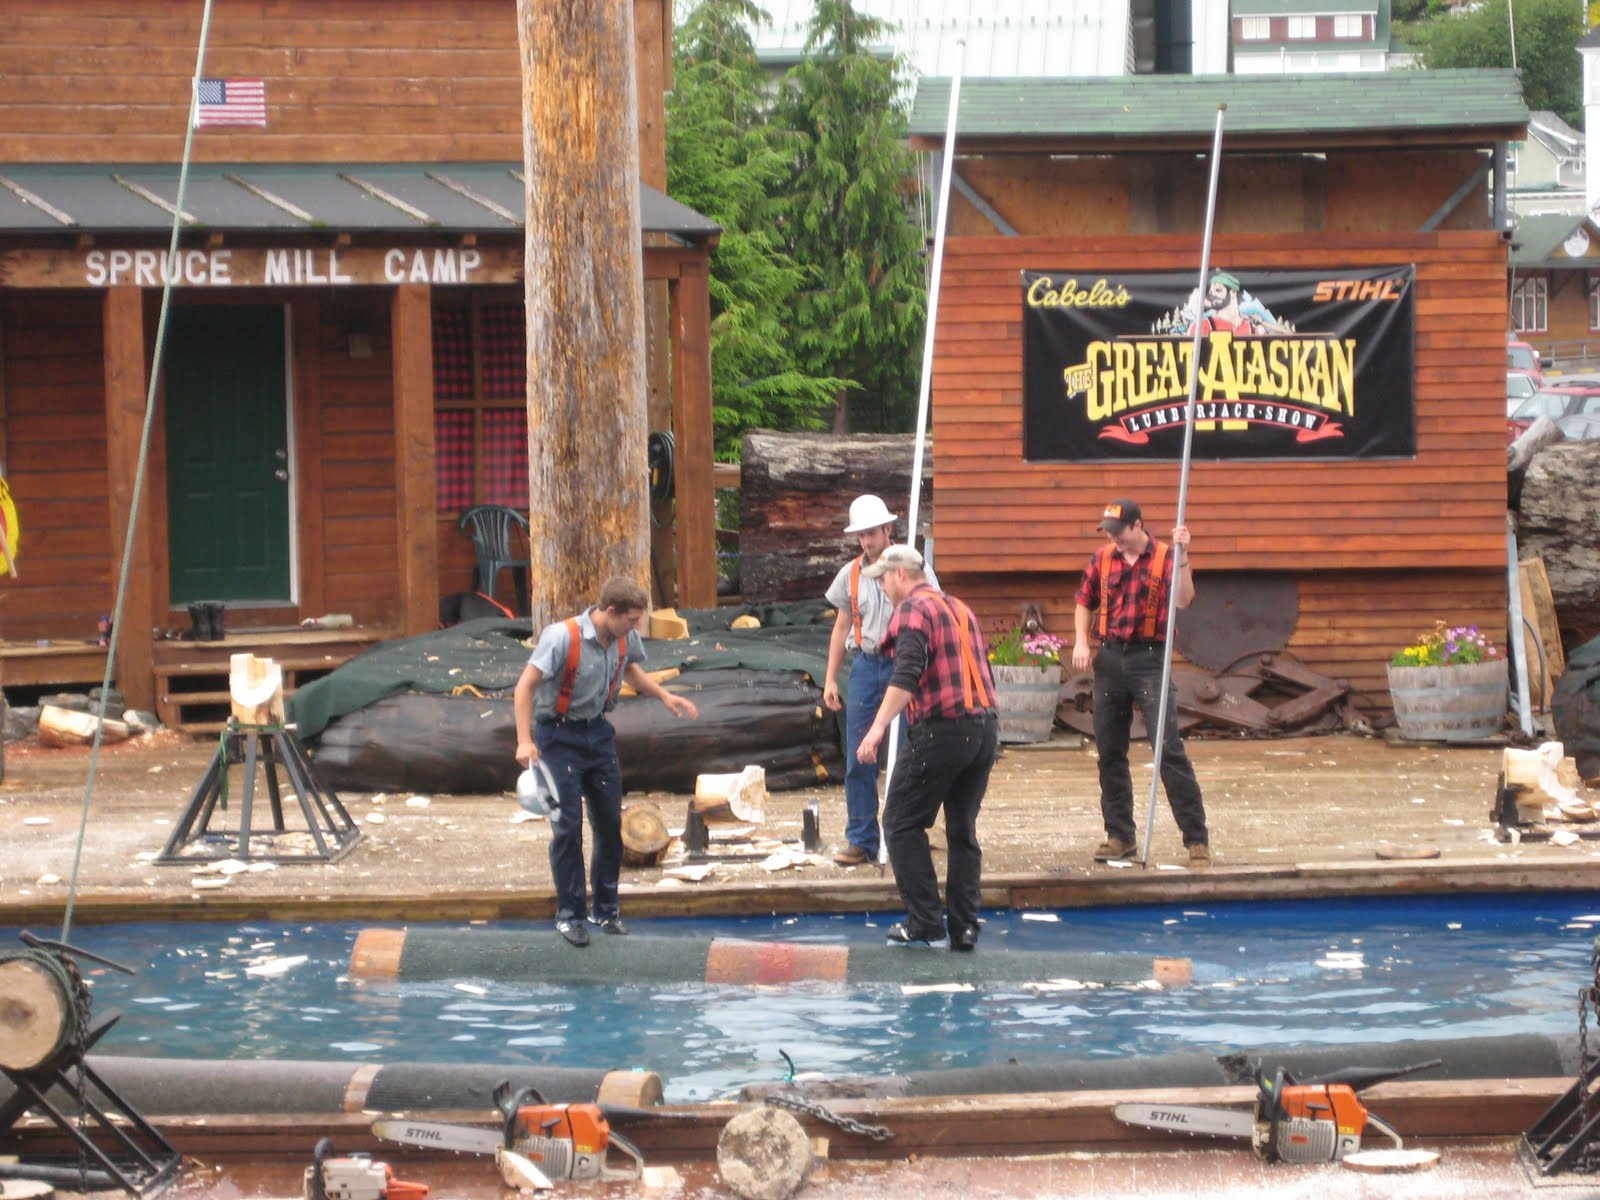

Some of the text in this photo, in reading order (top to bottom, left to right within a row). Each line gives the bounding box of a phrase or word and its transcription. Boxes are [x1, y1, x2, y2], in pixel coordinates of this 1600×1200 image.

[86, 248, 481, 285] SPRUCE MILL CAMP
[1027, 276, 1132, 308] Cabela's
[1313, 279, 1399, 302] STIHL
[1064, 331, 1356, 430] THE GREAT ALASKAN
[1265, 406, 1317, 429] SHOW
[1149, 1110, 1189, 1123] STIHL
[404, 1127, 443, 1141] STIHL
